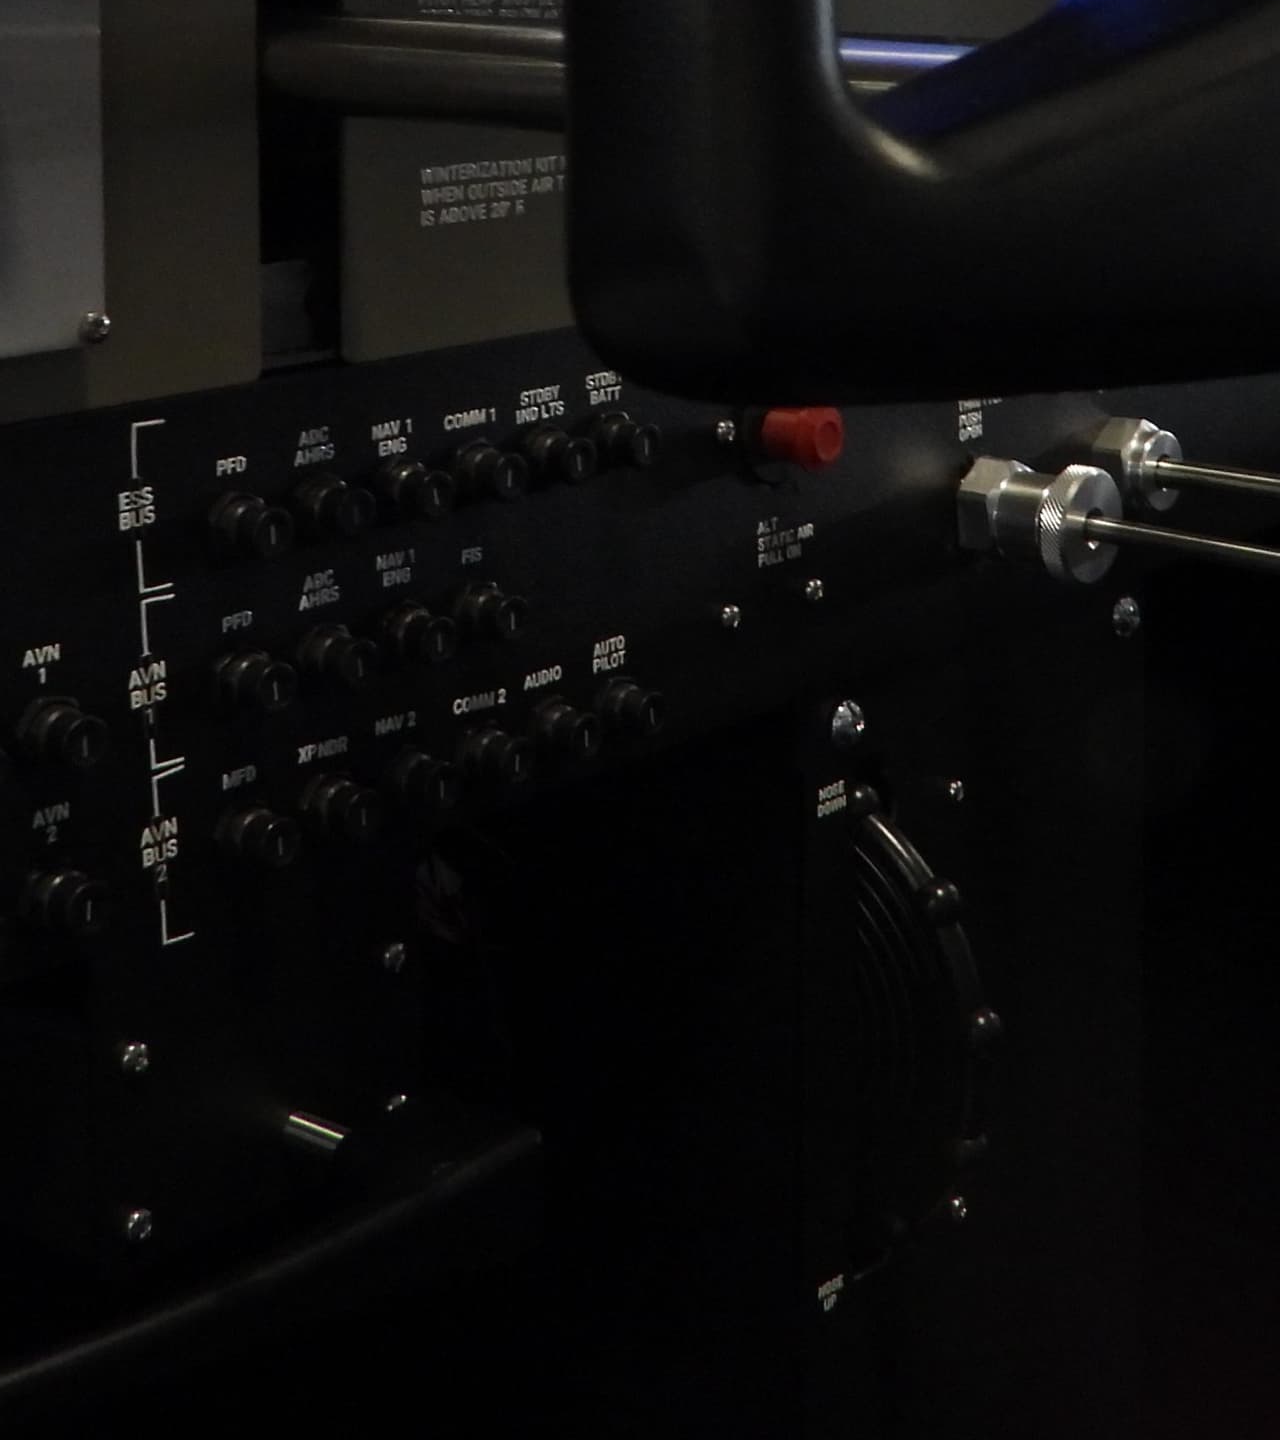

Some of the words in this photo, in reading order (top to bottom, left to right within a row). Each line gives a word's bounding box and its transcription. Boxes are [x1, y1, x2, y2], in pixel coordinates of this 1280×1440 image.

[421, 185, 465, 206] WHEN
[467, 179, 528, 200] OUTSIDE
[420, 210, 436, 227] IS
[438, 203, 487, 225] ABOVE
[588, 384, 622, 406] BATT
[443, 410, 483, 432] COMM
[487, 406, 497, 425] 1
[540, 400, 565, 419] LTS
[371, 422, 402, 442] NAV
[405, 417, 414, 436] 1
[294, 442, 337, 468] AHRS
[377, 437, 408, 458] ENG
[216, 455, 248, 478] PFD
[117, 485, 154, 510] ESS
[119, 507, 156, 532] BUS
[757, 528, 796, 552] STATIC
[376, 553, 406, 572] NAV
[407, 548, 416, 566] 1
[382, 567, 412, 589] ENG
[297, 584, 341, 612] AHRS
[222, 610, 253, 633] PFD
[22, 643, 61, 668] AVN
[593, 635, 626, 659] AUTO
[127, 660, 167, 688] AVN
[593, 651, 626, 675] PILOT
[38, 669, 47, 684] 1
[523, 664, 562, 691] AUDIO
[130, 683, 168, 710] BUS
[452, 692, 493, 715] COMM
[495, 688, 507, 706] 2
[144, 708, 155, 725] 1
[375, 714, 404, 737] NAV
[405, 710, 417, 728] 2
[222, 764, 257, 790] MFD
[32, 802, 71, 830] AVN
[45, 825, 59, 843] 2
[139, 817, 179, 846] AVN
[141, 839, 179, 869] BUS
[155, 864, 168, 883] 2
